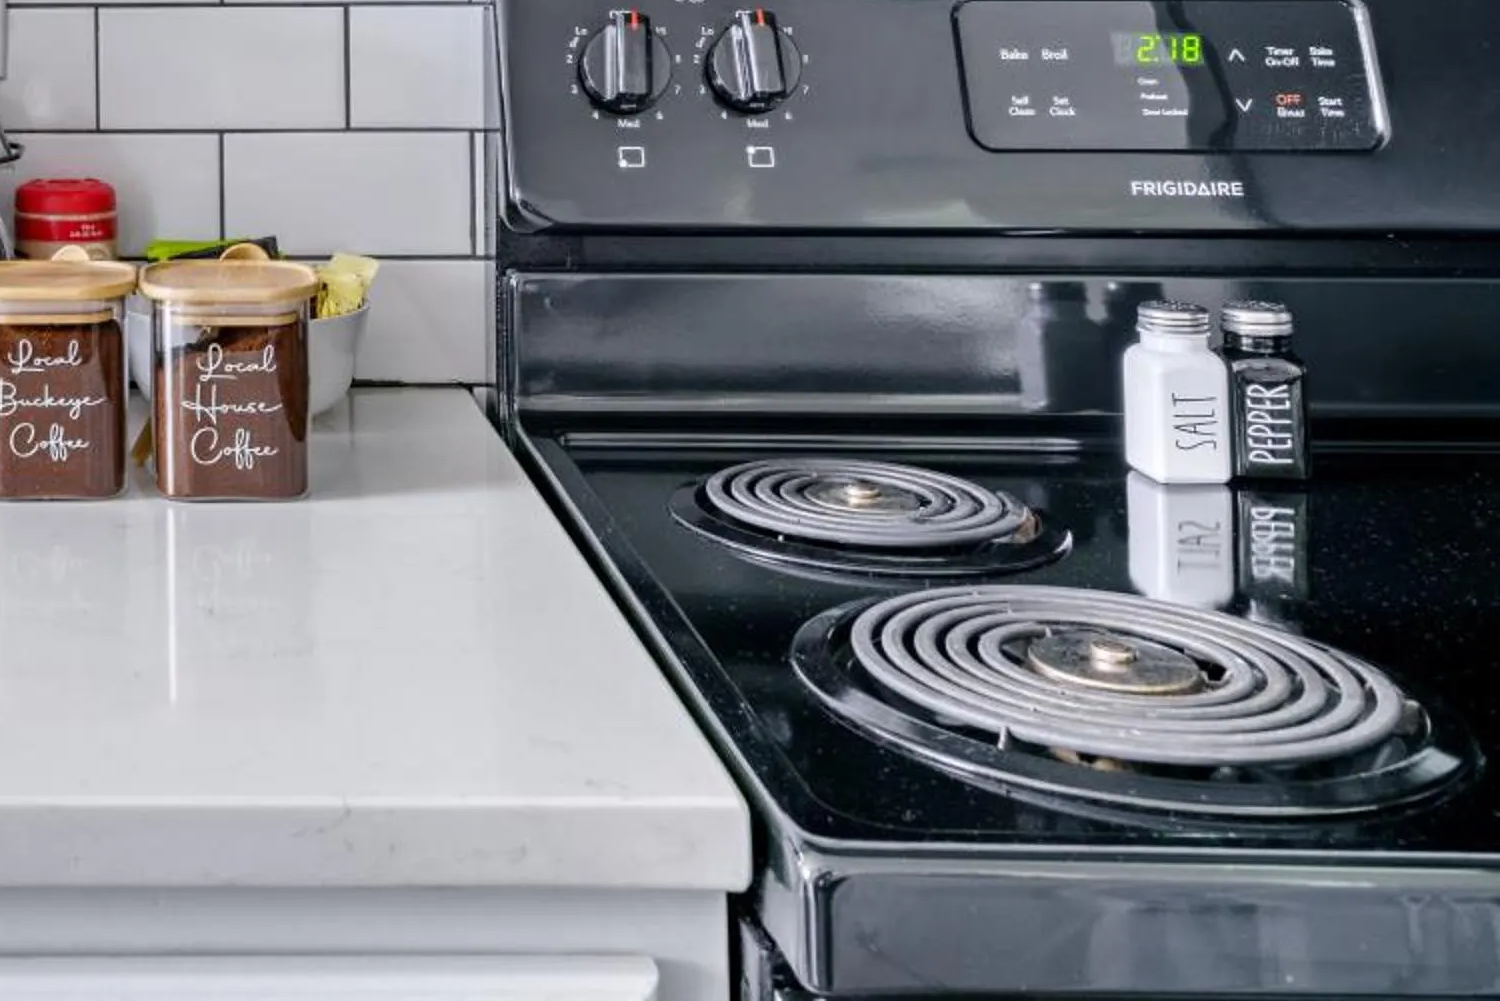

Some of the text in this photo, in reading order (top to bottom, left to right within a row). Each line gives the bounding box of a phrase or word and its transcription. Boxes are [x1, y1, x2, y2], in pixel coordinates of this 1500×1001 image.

[1130, 180, 1245, 197] FRIGIDAIRE
[7, 338, 83, 374] Local
[195, 342, 278, 382] Local
[180, 383, 283, 425] House
[1171, 392, 1219, 451] SALT
[1245, 383, 1294, 465] PEPPER
[9, 422, 90, 462] Coffee
[191, 426, 280, 470] Coffee
